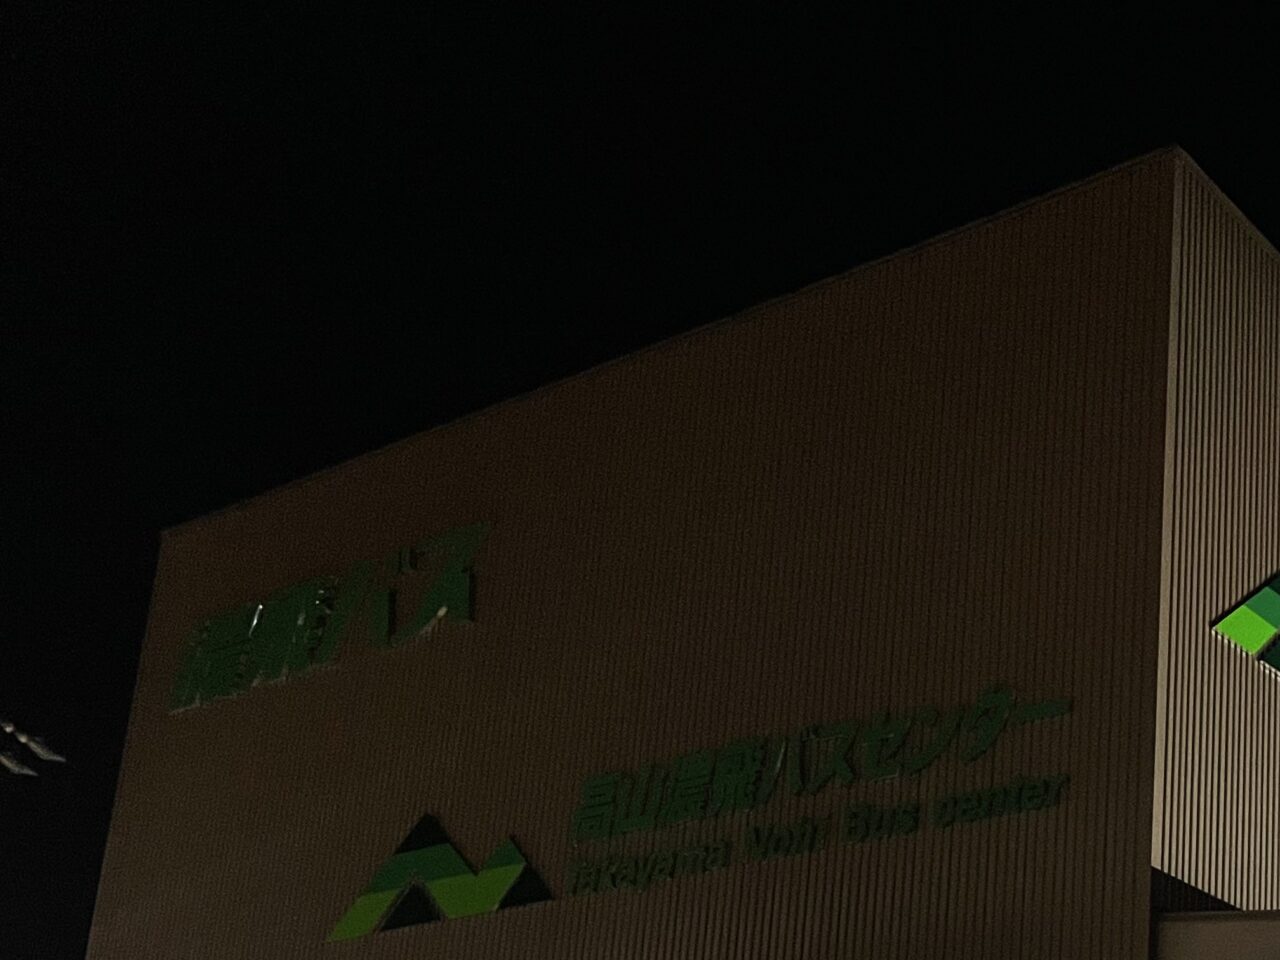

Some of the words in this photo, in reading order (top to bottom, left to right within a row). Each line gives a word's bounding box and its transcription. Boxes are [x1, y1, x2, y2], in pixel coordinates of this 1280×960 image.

[572, 682, 1072, 840] 高山濃飛バスセンター
